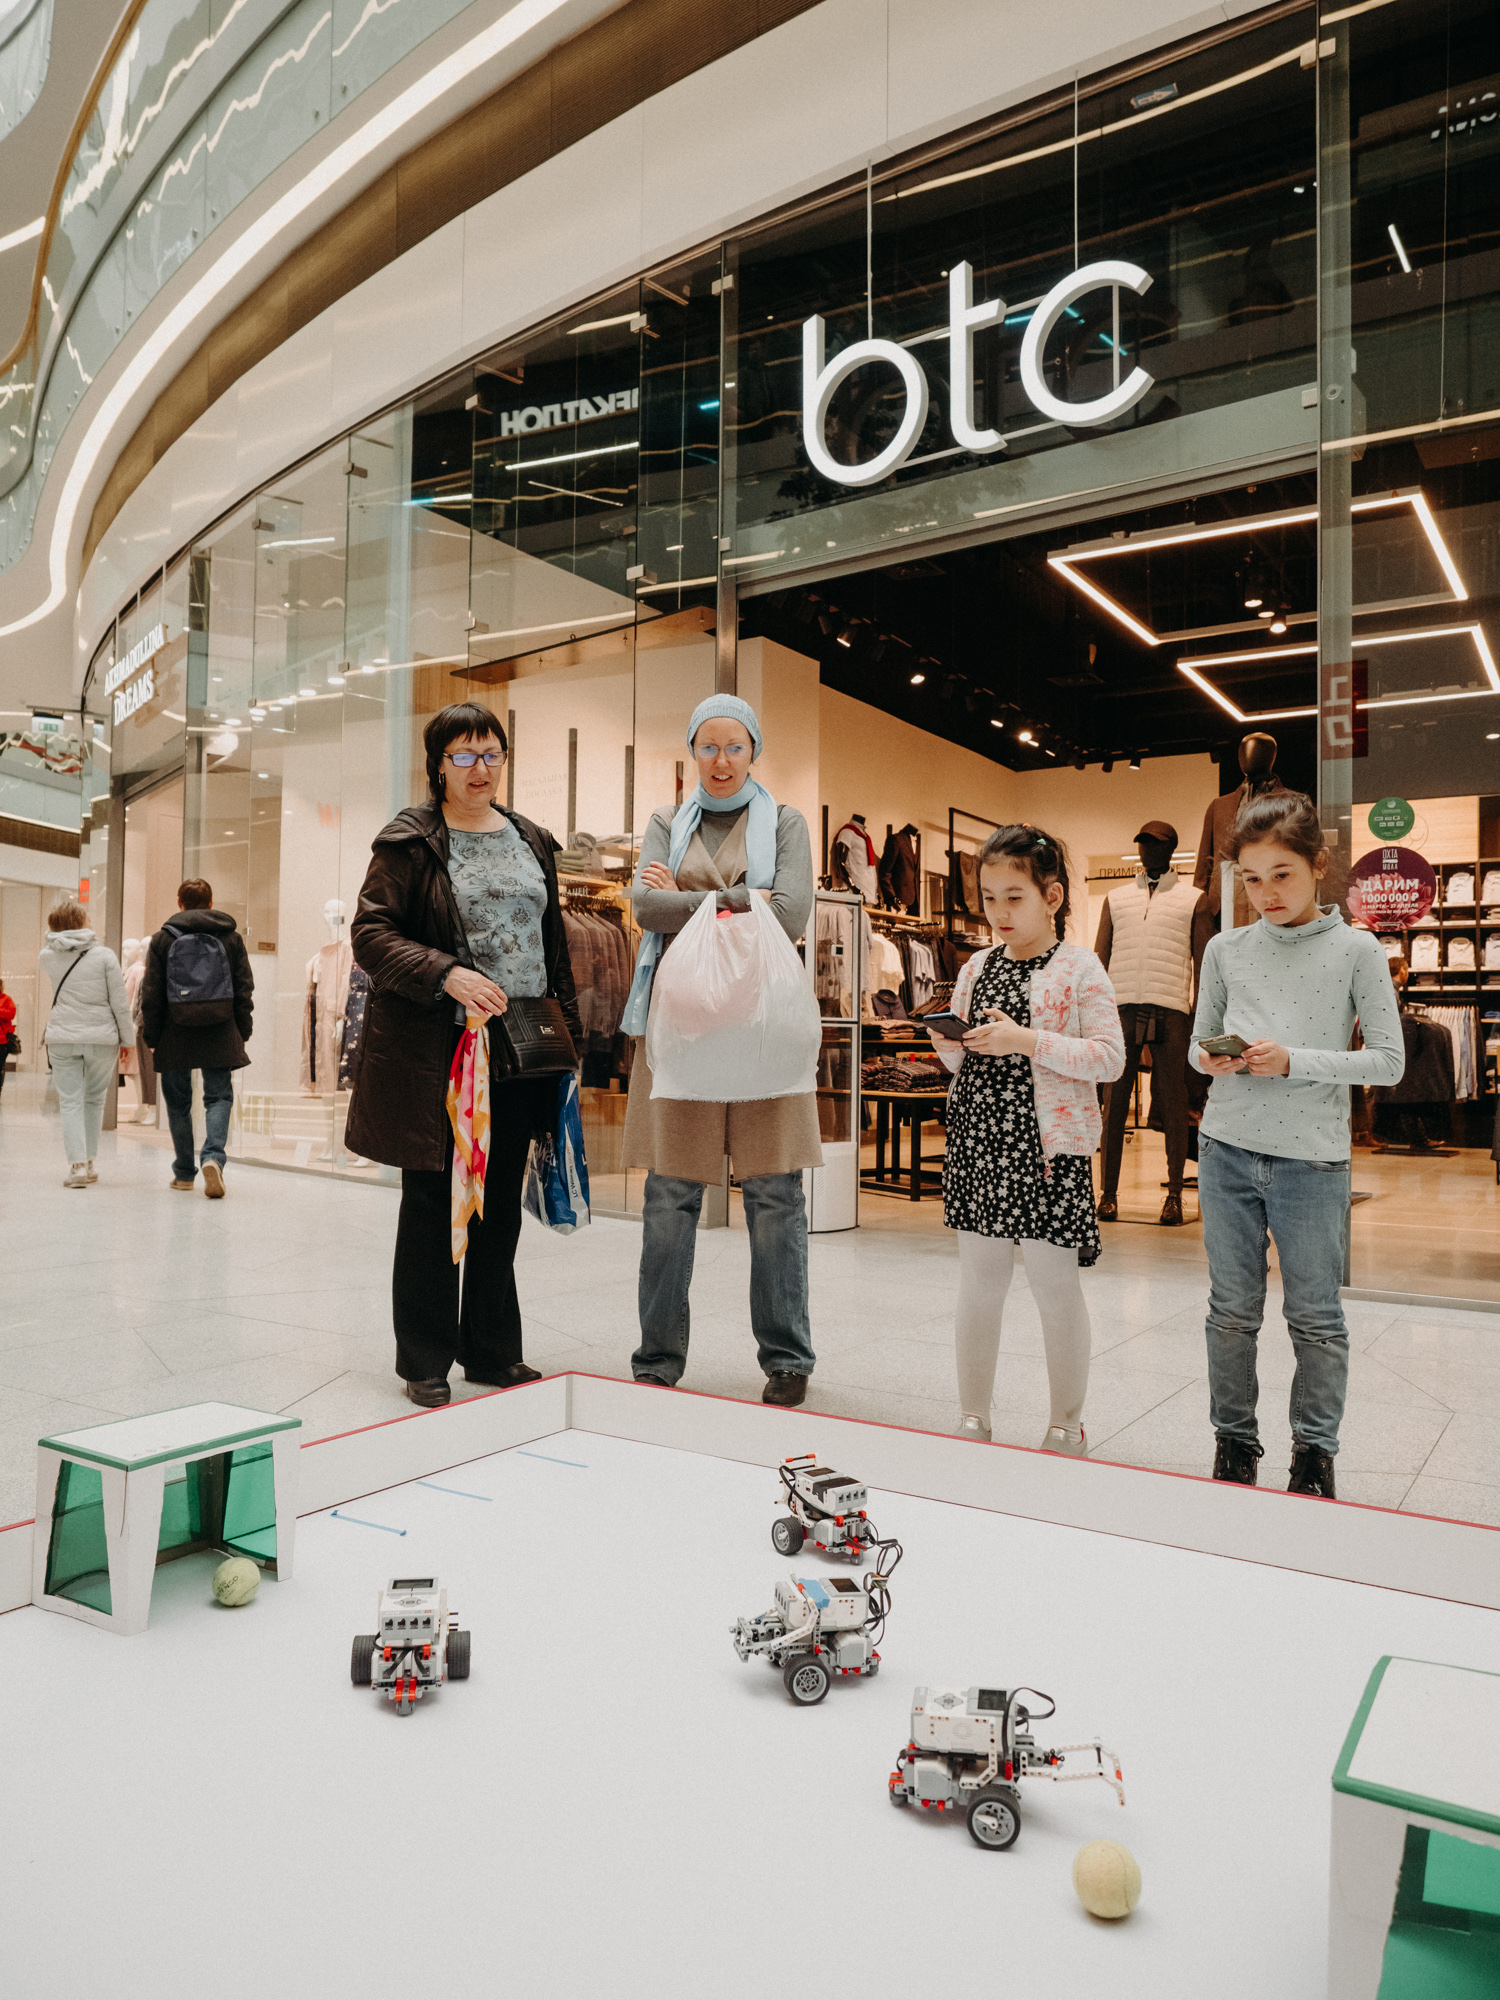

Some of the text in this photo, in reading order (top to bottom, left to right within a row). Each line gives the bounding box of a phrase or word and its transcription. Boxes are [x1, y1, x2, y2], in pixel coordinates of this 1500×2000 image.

[802, 259, 1155, 487] btc
[104, 622, 166, 697] AKHMADULLINA
[114, 668, 155, 726] DREAMS
[1099, 863, 1181, 878] ПРИМЕРЕ
[1382, 849, 1398, 859] ОХТА
[1361, 879, 1419, 893] ДАРИМ
